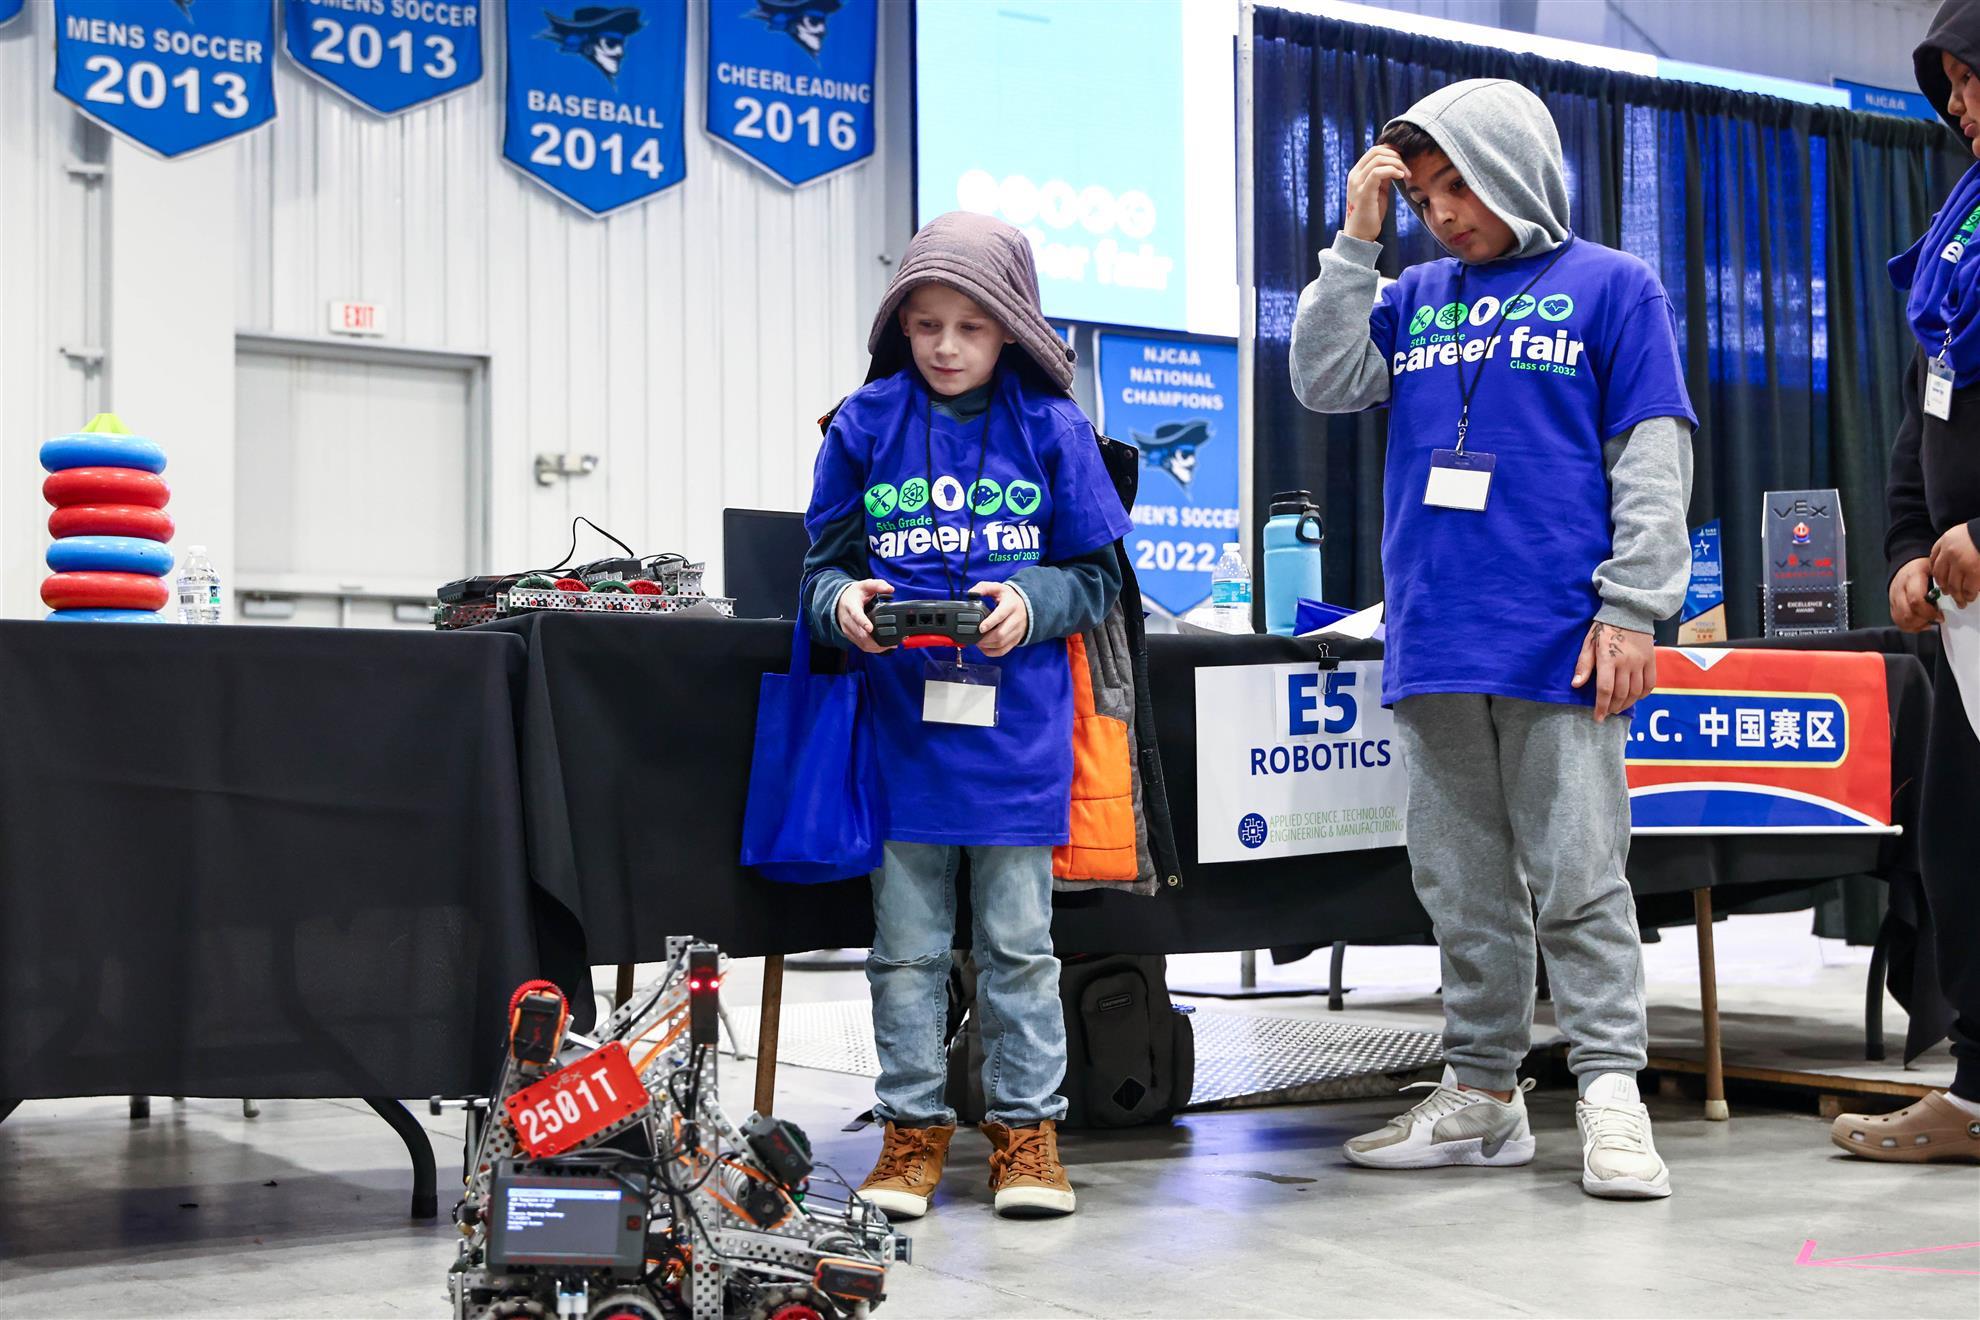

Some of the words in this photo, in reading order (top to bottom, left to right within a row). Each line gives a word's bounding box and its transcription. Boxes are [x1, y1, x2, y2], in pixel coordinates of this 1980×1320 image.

[294, 0, 386, 16] ENS
[391, 0, 477, 27] SOCCER
[66, 15, 146, 50] MENS
[155, 28, 262, 64] SOCCER
[310, 17, 458, 80] 2013
[84, 55, 250, 119] 2013
[717, 62, 871, 104] CHEERLEADING
[528, 90, 663, 129] BASEBALL
[1865, 92, 1907, 111] NJCAA
[732, 97, 857, 151] 2016
[530, 123, 664, 180] 2014
[344, 303, 375, 328] EXIT
[1143, 347, 1201, 367] NJCAA
[1393, 333, 1502, 376] career
[1509, 326, 1585, 366] fair
[1409, 336, 1427, 349] 5th
[1130, 367, 1216, 389] NATIONAL
[1510, 360, 1537, 371] Class
[1539, 362, 1551, 372] of
[1552, 364, 1577, 377] 2032
[1122, 388, 1224, 411] CHAMPIONS
[876, 522, 897, 532] 5th
[898, 515, 933, 529] Grade
[1773, 499, 1830, 520] VEX
[868, 525, 976, 559] career
[982, 519, 1041, 551] fair
[988, 552, 1011, 562] Class
[1013, 552, 1022, 561] of
[1136, 539, 1217, 572] 2022
[1288, 672, 1358, 736] E5
[1626, 709, 1683, 743] .C.
[1699, 707, 1837, 749] 中国赛区
[1250, 739, 1391, 776] ROBOTICS
[1270, 813, 1302, 828] APPLIED
[1342, 805, 1398, 821] TECHNOLOGY,
[1270, 825, 1327, 843] ENGINEERING
[1328, 825, 1335, 838] &
[1335, 818, 1404, 837] MANUFACTURING
[551, 1071, 583, 1090] VEX
[519, 1067, 618, 1145] 2501T
